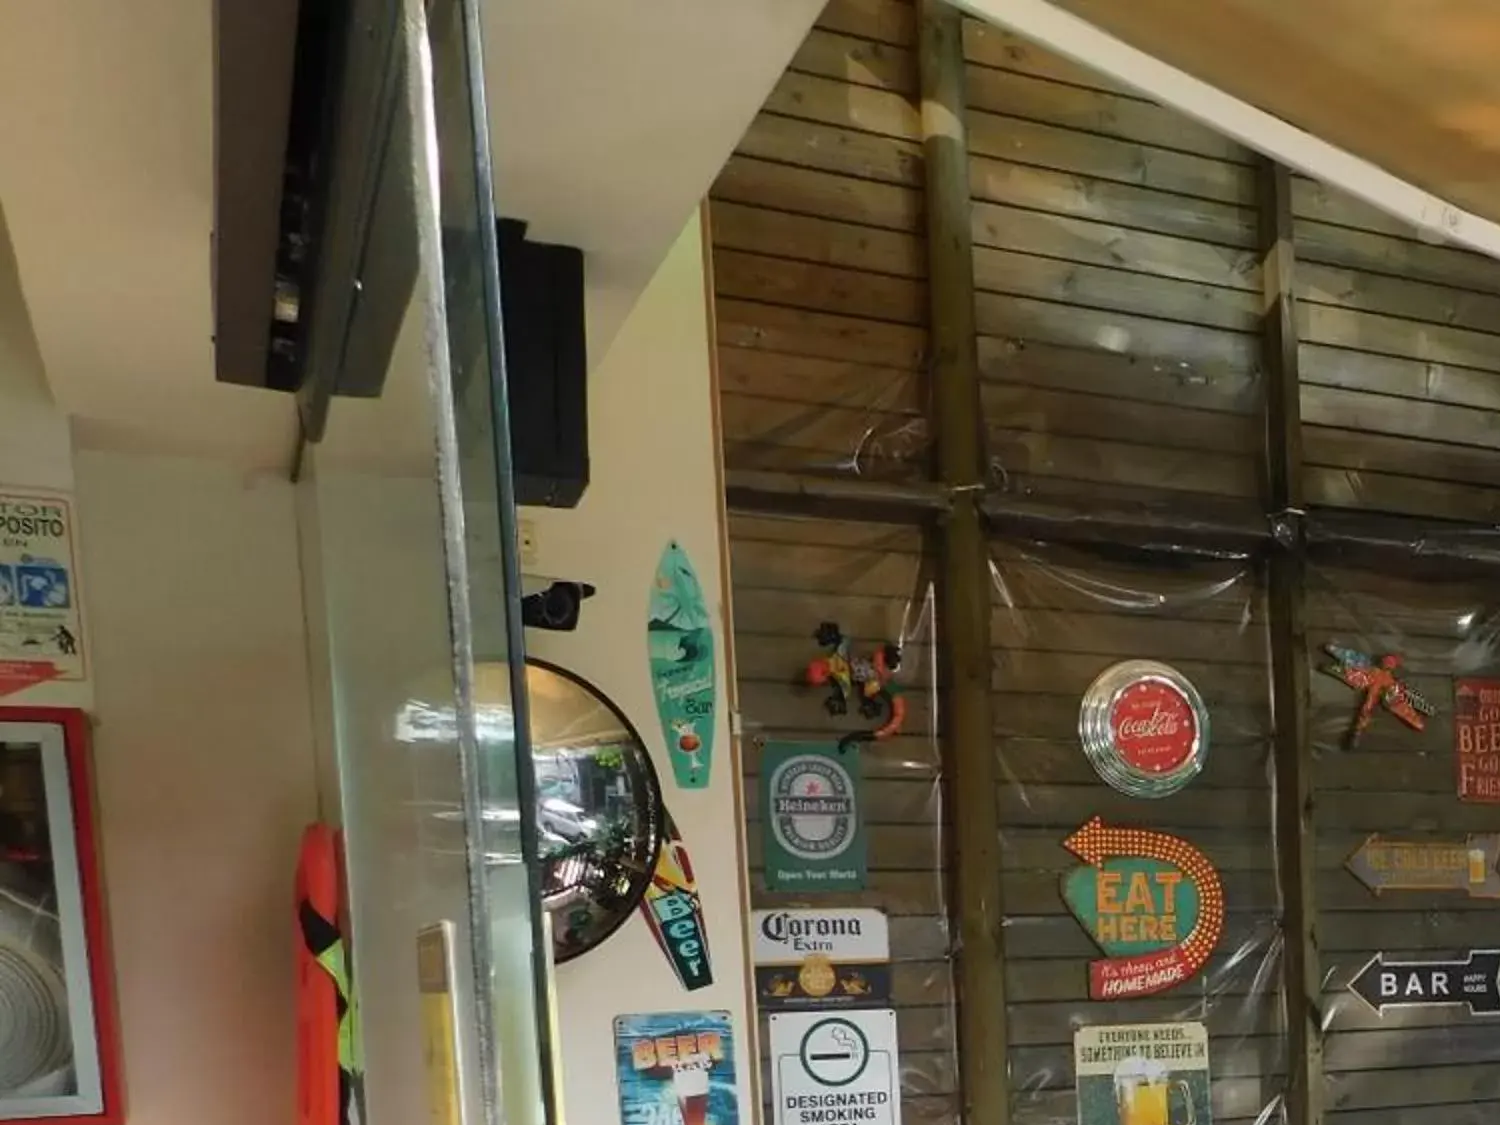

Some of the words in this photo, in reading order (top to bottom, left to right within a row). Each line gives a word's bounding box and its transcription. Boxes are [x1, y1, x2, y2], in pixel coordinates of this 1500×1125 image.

[779, 798, 848, 813] Heineken
[777, 869, 803, 882] Open
[1097, 871, 1182, 914] EAT
[761, 912, 862, 944] Corona
[1096, 914, 1177, 942] HERE
[793, 938, 833, 951] Extra
[1102, 963, 1185, 996] HOMEMADE
[1380, 972, 1450, 996] BAR
[1099, 1030, 1150, 1043] EVERYONE
[632, 1032, 724, 1069] BEER
[1081, 1045, 1138, 1063] SOMETHING
[1153, 1043, 1192, 1059] BELIEVE
[786, 1091, 888, 1110] DESIGNATED
[800, 1107, 876, 1123] SMOKING
